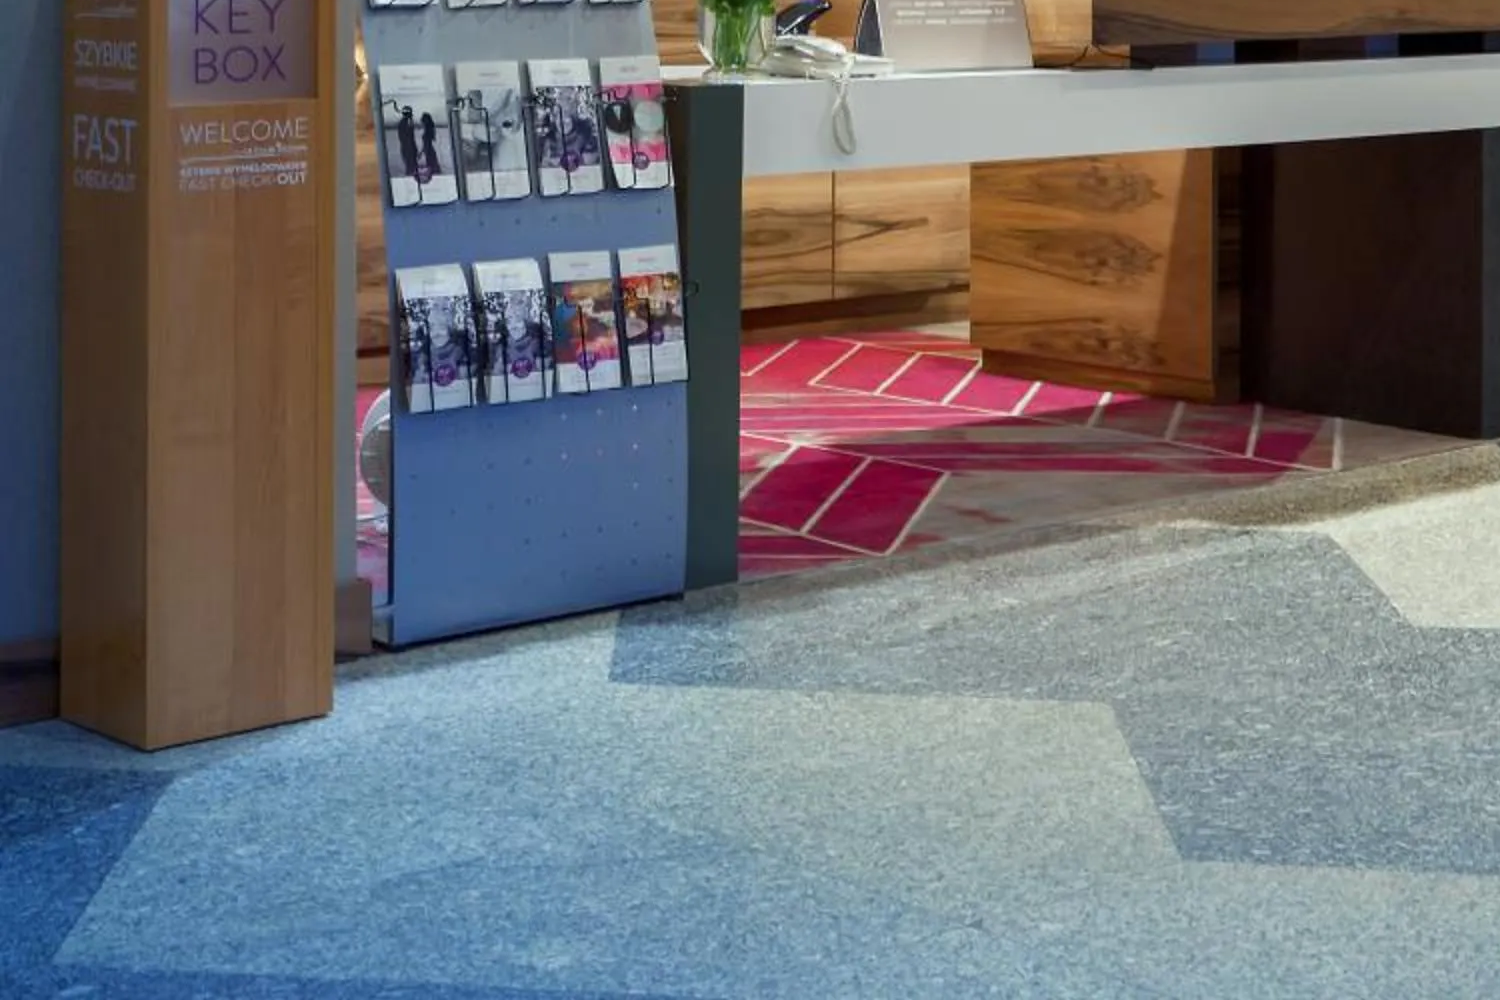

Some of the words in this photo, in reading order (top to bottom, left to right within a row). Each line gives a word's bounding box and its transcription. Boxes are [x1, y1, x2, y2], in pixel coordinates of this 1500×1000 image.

[194, 45, 287, 85] BOX
[73, 113, 138, 168] FAST
[179, 116, 309, 145] WELCOME
